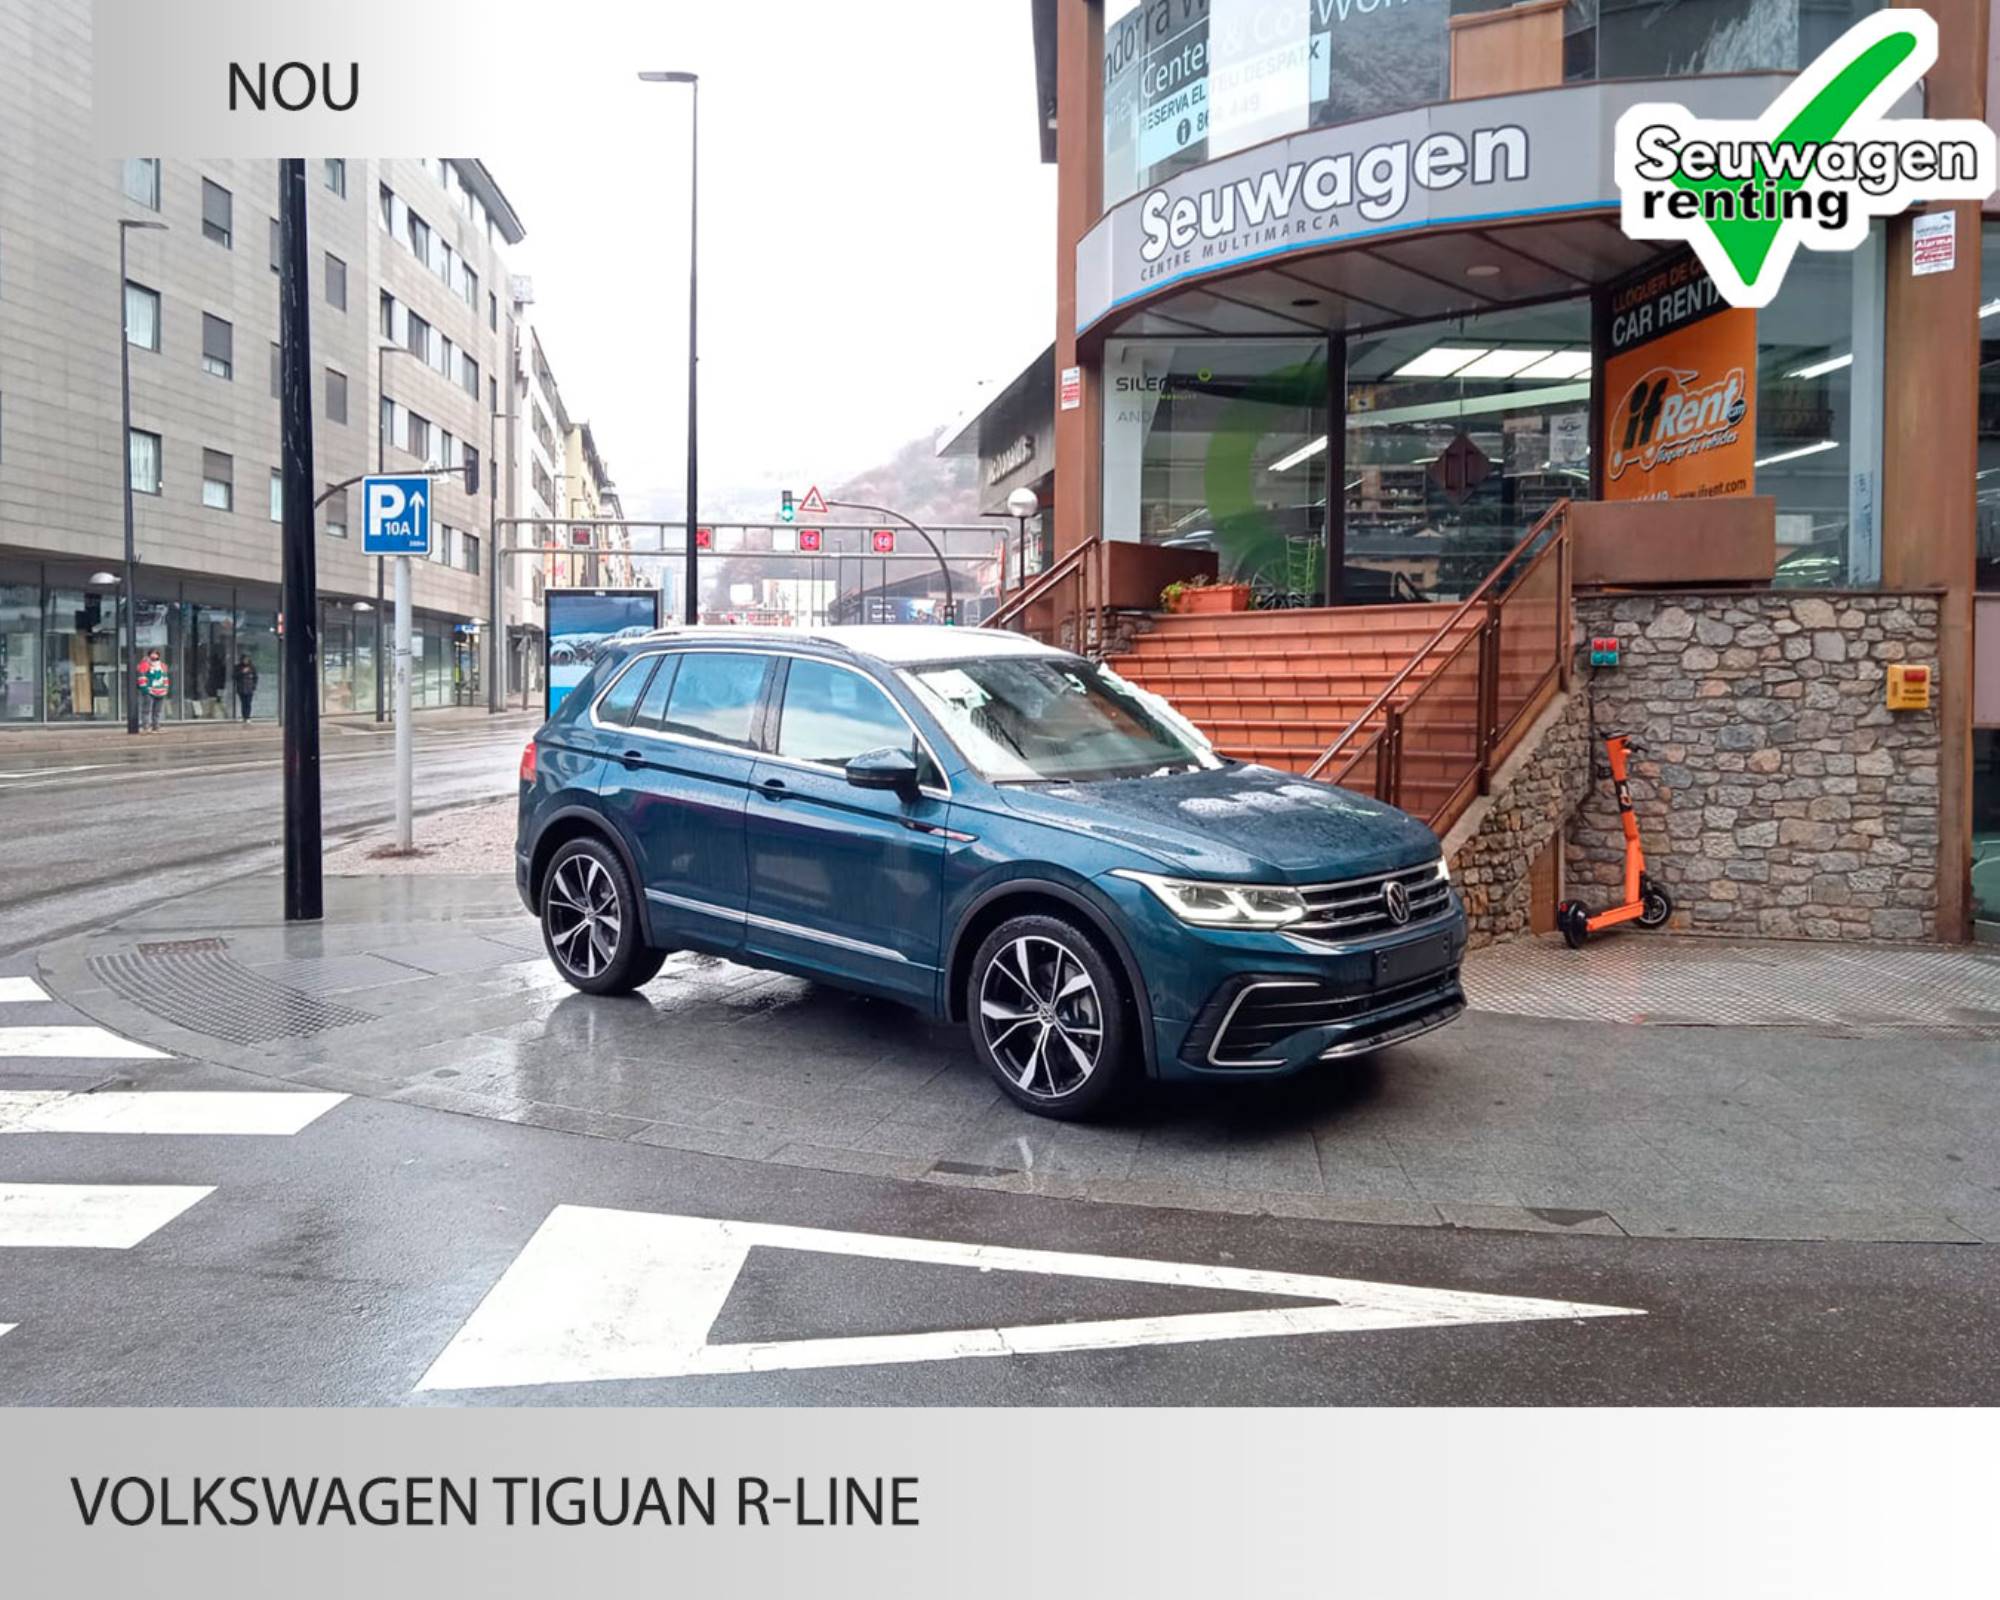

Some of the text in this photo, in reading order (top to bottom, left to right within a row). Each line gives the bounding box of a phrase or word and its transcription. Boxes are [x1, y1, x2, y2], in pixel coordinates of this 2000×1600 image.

[1191, 83, 1206, 106] EL
[1140, 124, 1528, 263] Seuwagen
[1141, 214, 1340, 282] CENTRE MULTIMARCA
[1614, 271, 1668, 313] LLOGUER
[1669, 261, 1690, 287] DE
[1612, 304, 1653, 347] CAR
[370, 484, 406, 536] P
[385, 521, 411, 536] 10A
